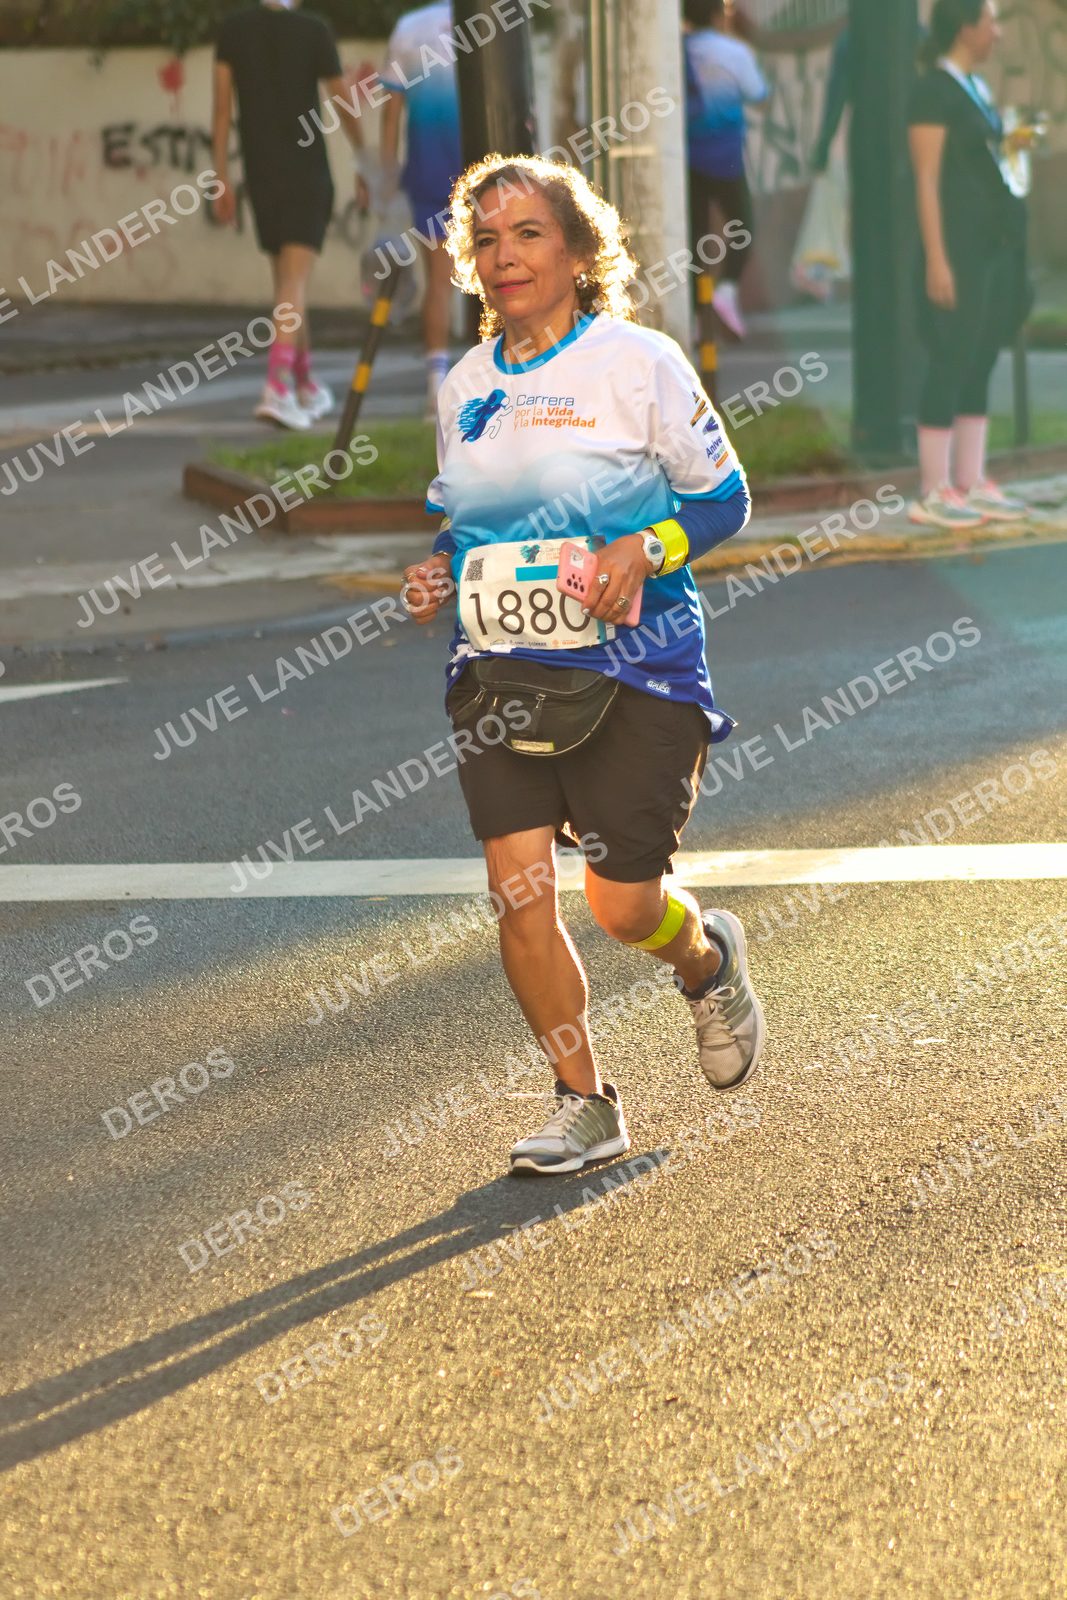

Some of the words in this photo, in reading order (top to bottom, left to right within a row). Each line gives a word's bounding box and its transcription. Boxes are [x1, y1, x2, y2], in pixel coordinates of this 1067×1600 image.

[516, 394, 575, 406] Carrera
[515, 408, 530, 418] por
[533, 406, 543, 416] la
[546, 407, 574, 416] Vida
[513, 419, 519, 431] y
[520, 418, 529, 428] la
[531, 417, 596, 428] Integridad
[468, 588, 591, 636] 1880
